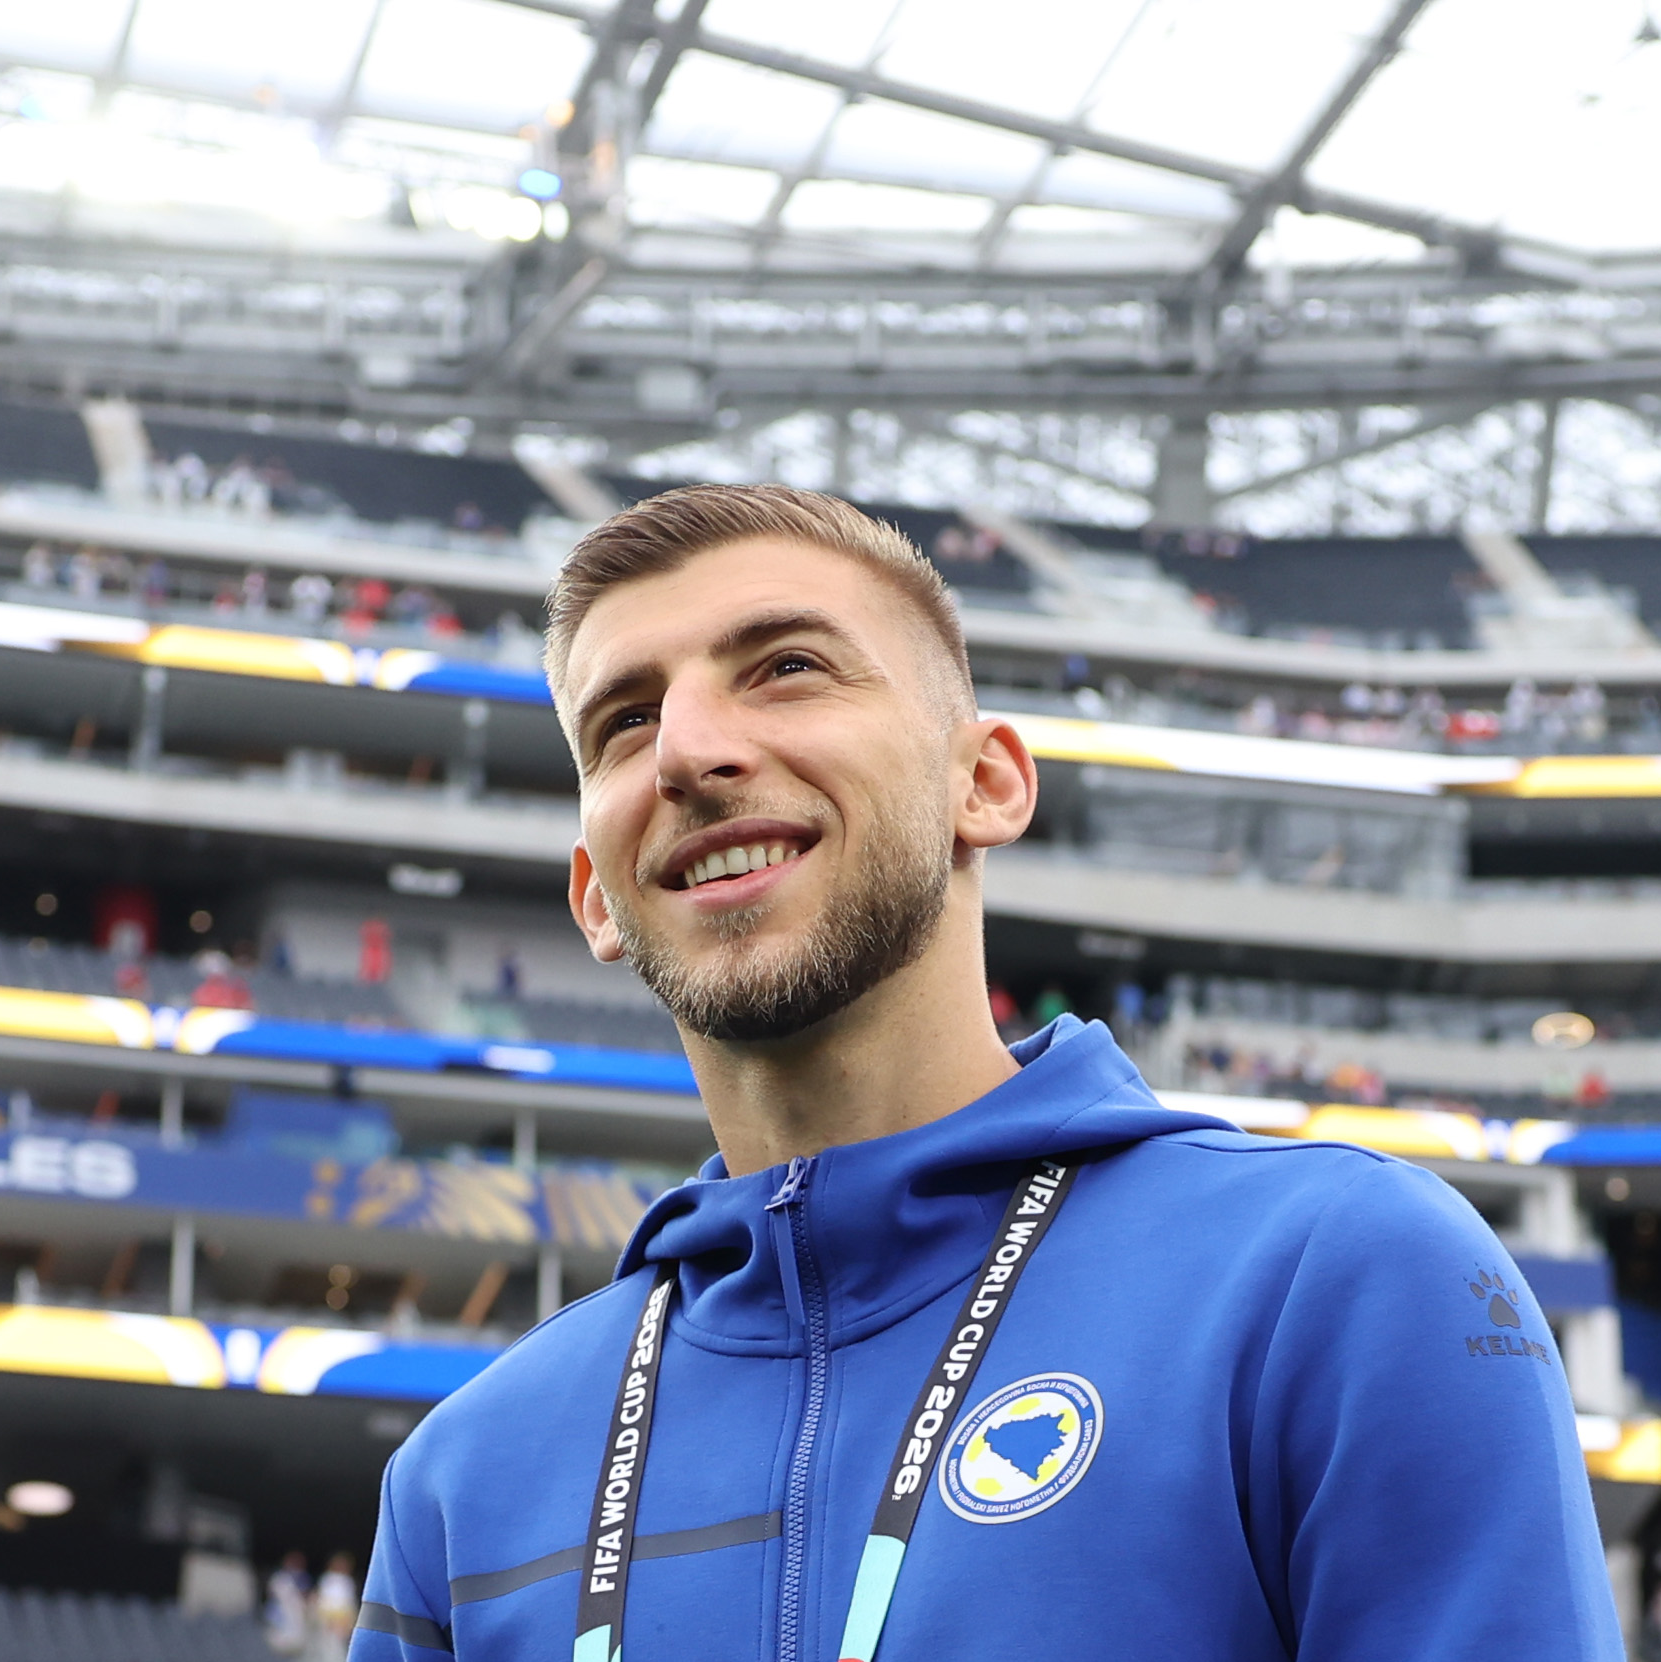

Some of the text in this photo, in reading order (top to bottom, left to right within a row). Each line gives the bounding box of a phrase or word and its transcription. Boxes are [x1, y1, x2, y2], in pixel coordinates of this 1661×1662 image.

[1016, 1159, 1067, 1216] FIFA
[970, 1220, 1039, 1320] WORLD
[942, 1323, 985, 1382] CUP
[589, 1278, 675, 1595] FIFA WORLD CUP 2026
